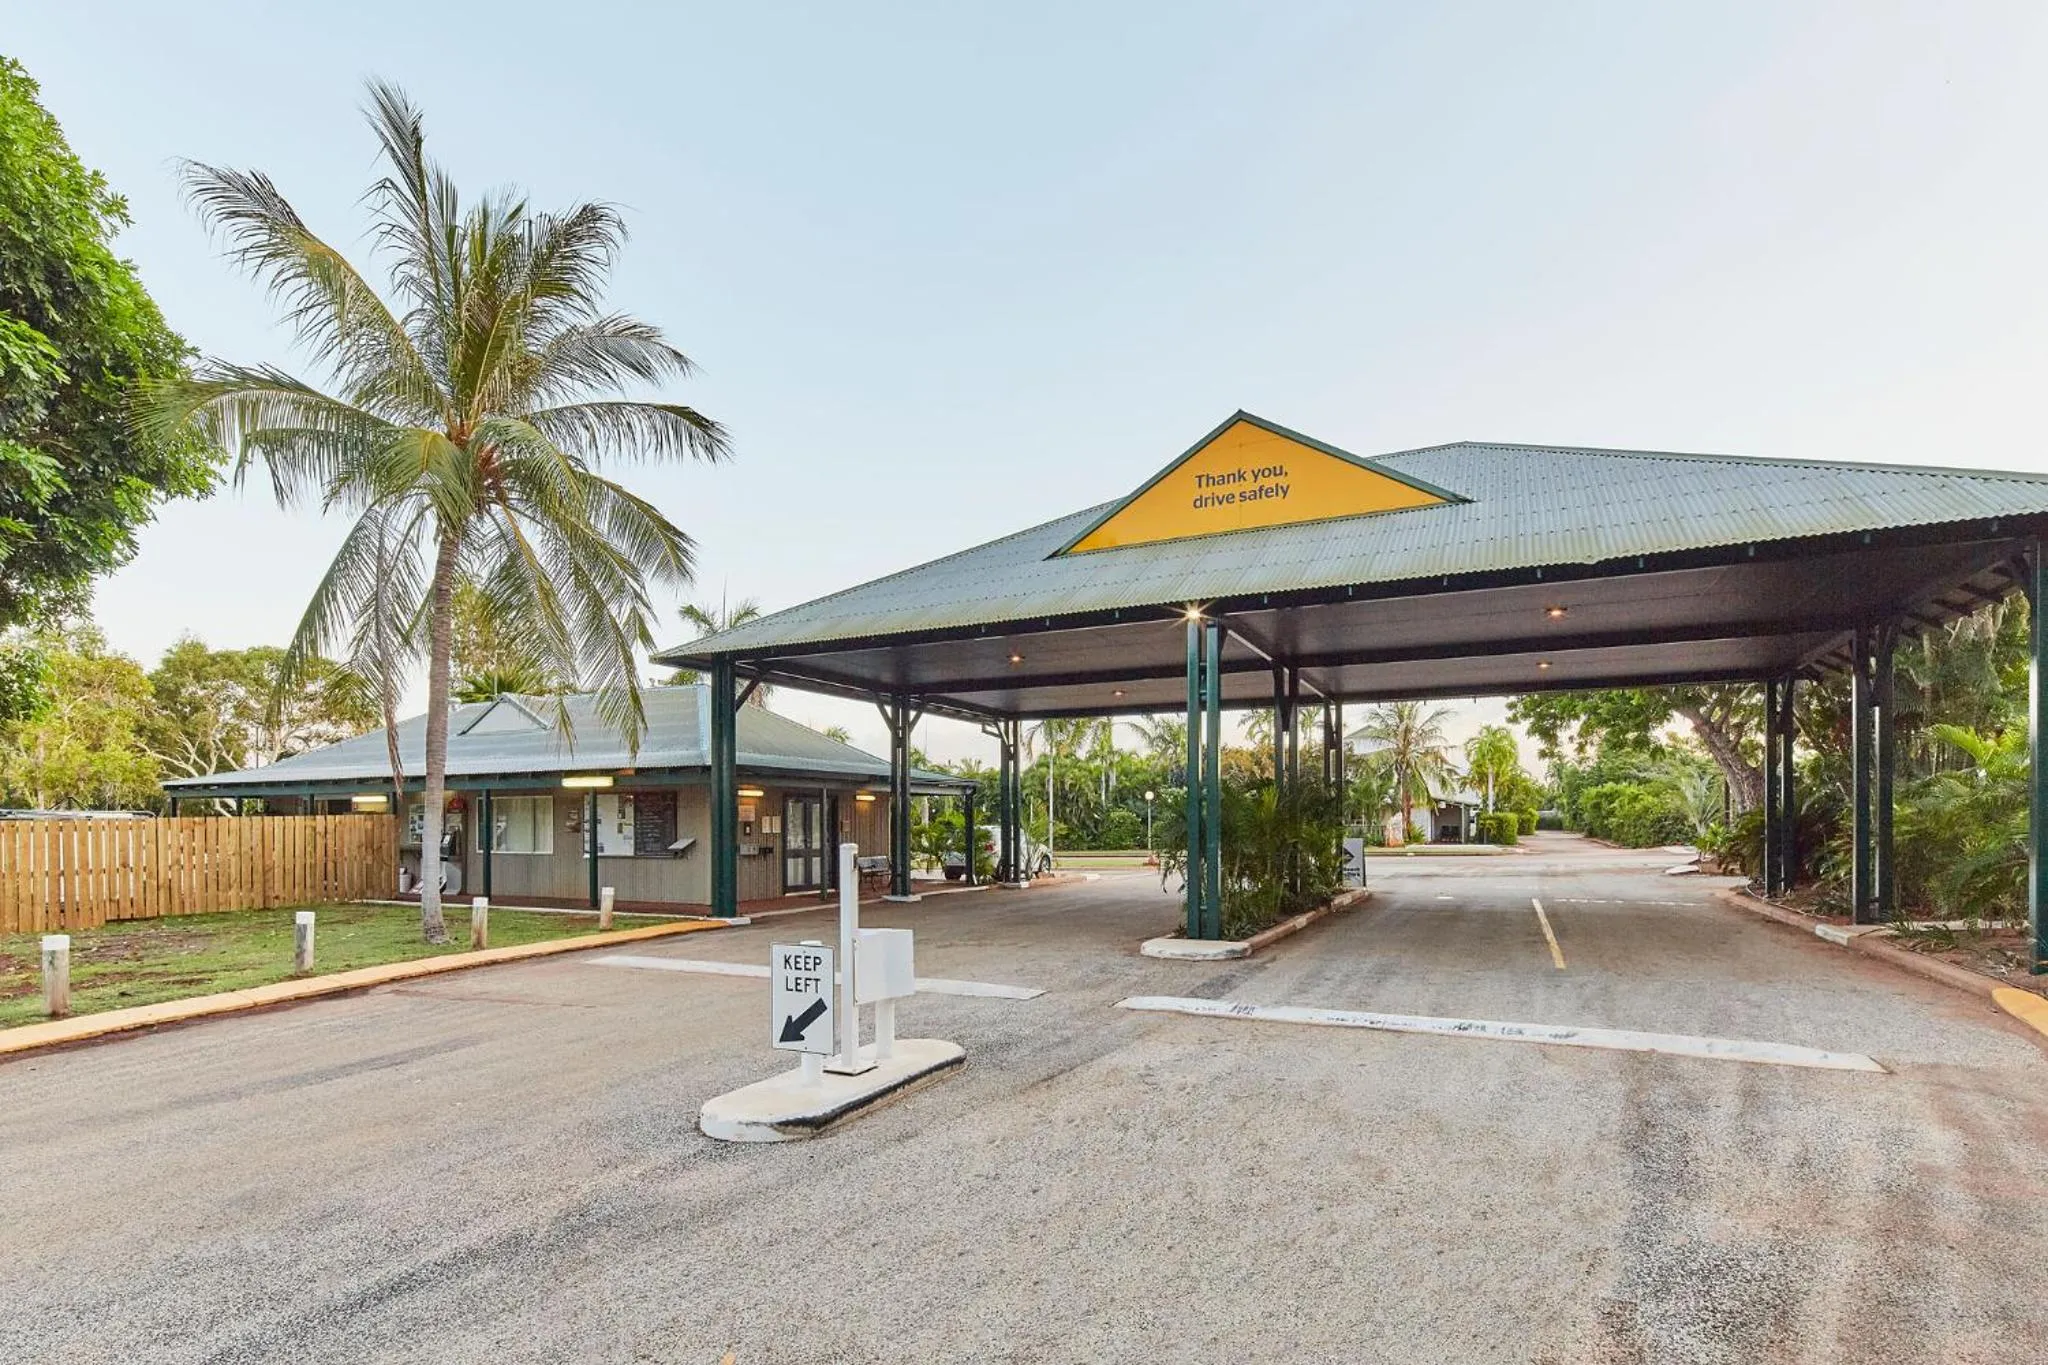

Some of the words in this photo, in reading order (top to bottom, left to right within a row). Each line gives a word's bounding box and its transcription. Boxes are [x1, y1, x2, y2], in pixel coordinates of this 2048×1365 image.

[1195, 468, 1247, 488] Thank
[1251, 465, 1288, 483] you,
[1193, 492, 1235, 509] drive
[1239, 483, 1290, 503] safely
[784, 954, 822, 972] KEEP
[786, 976, 821, 994] LEFT
